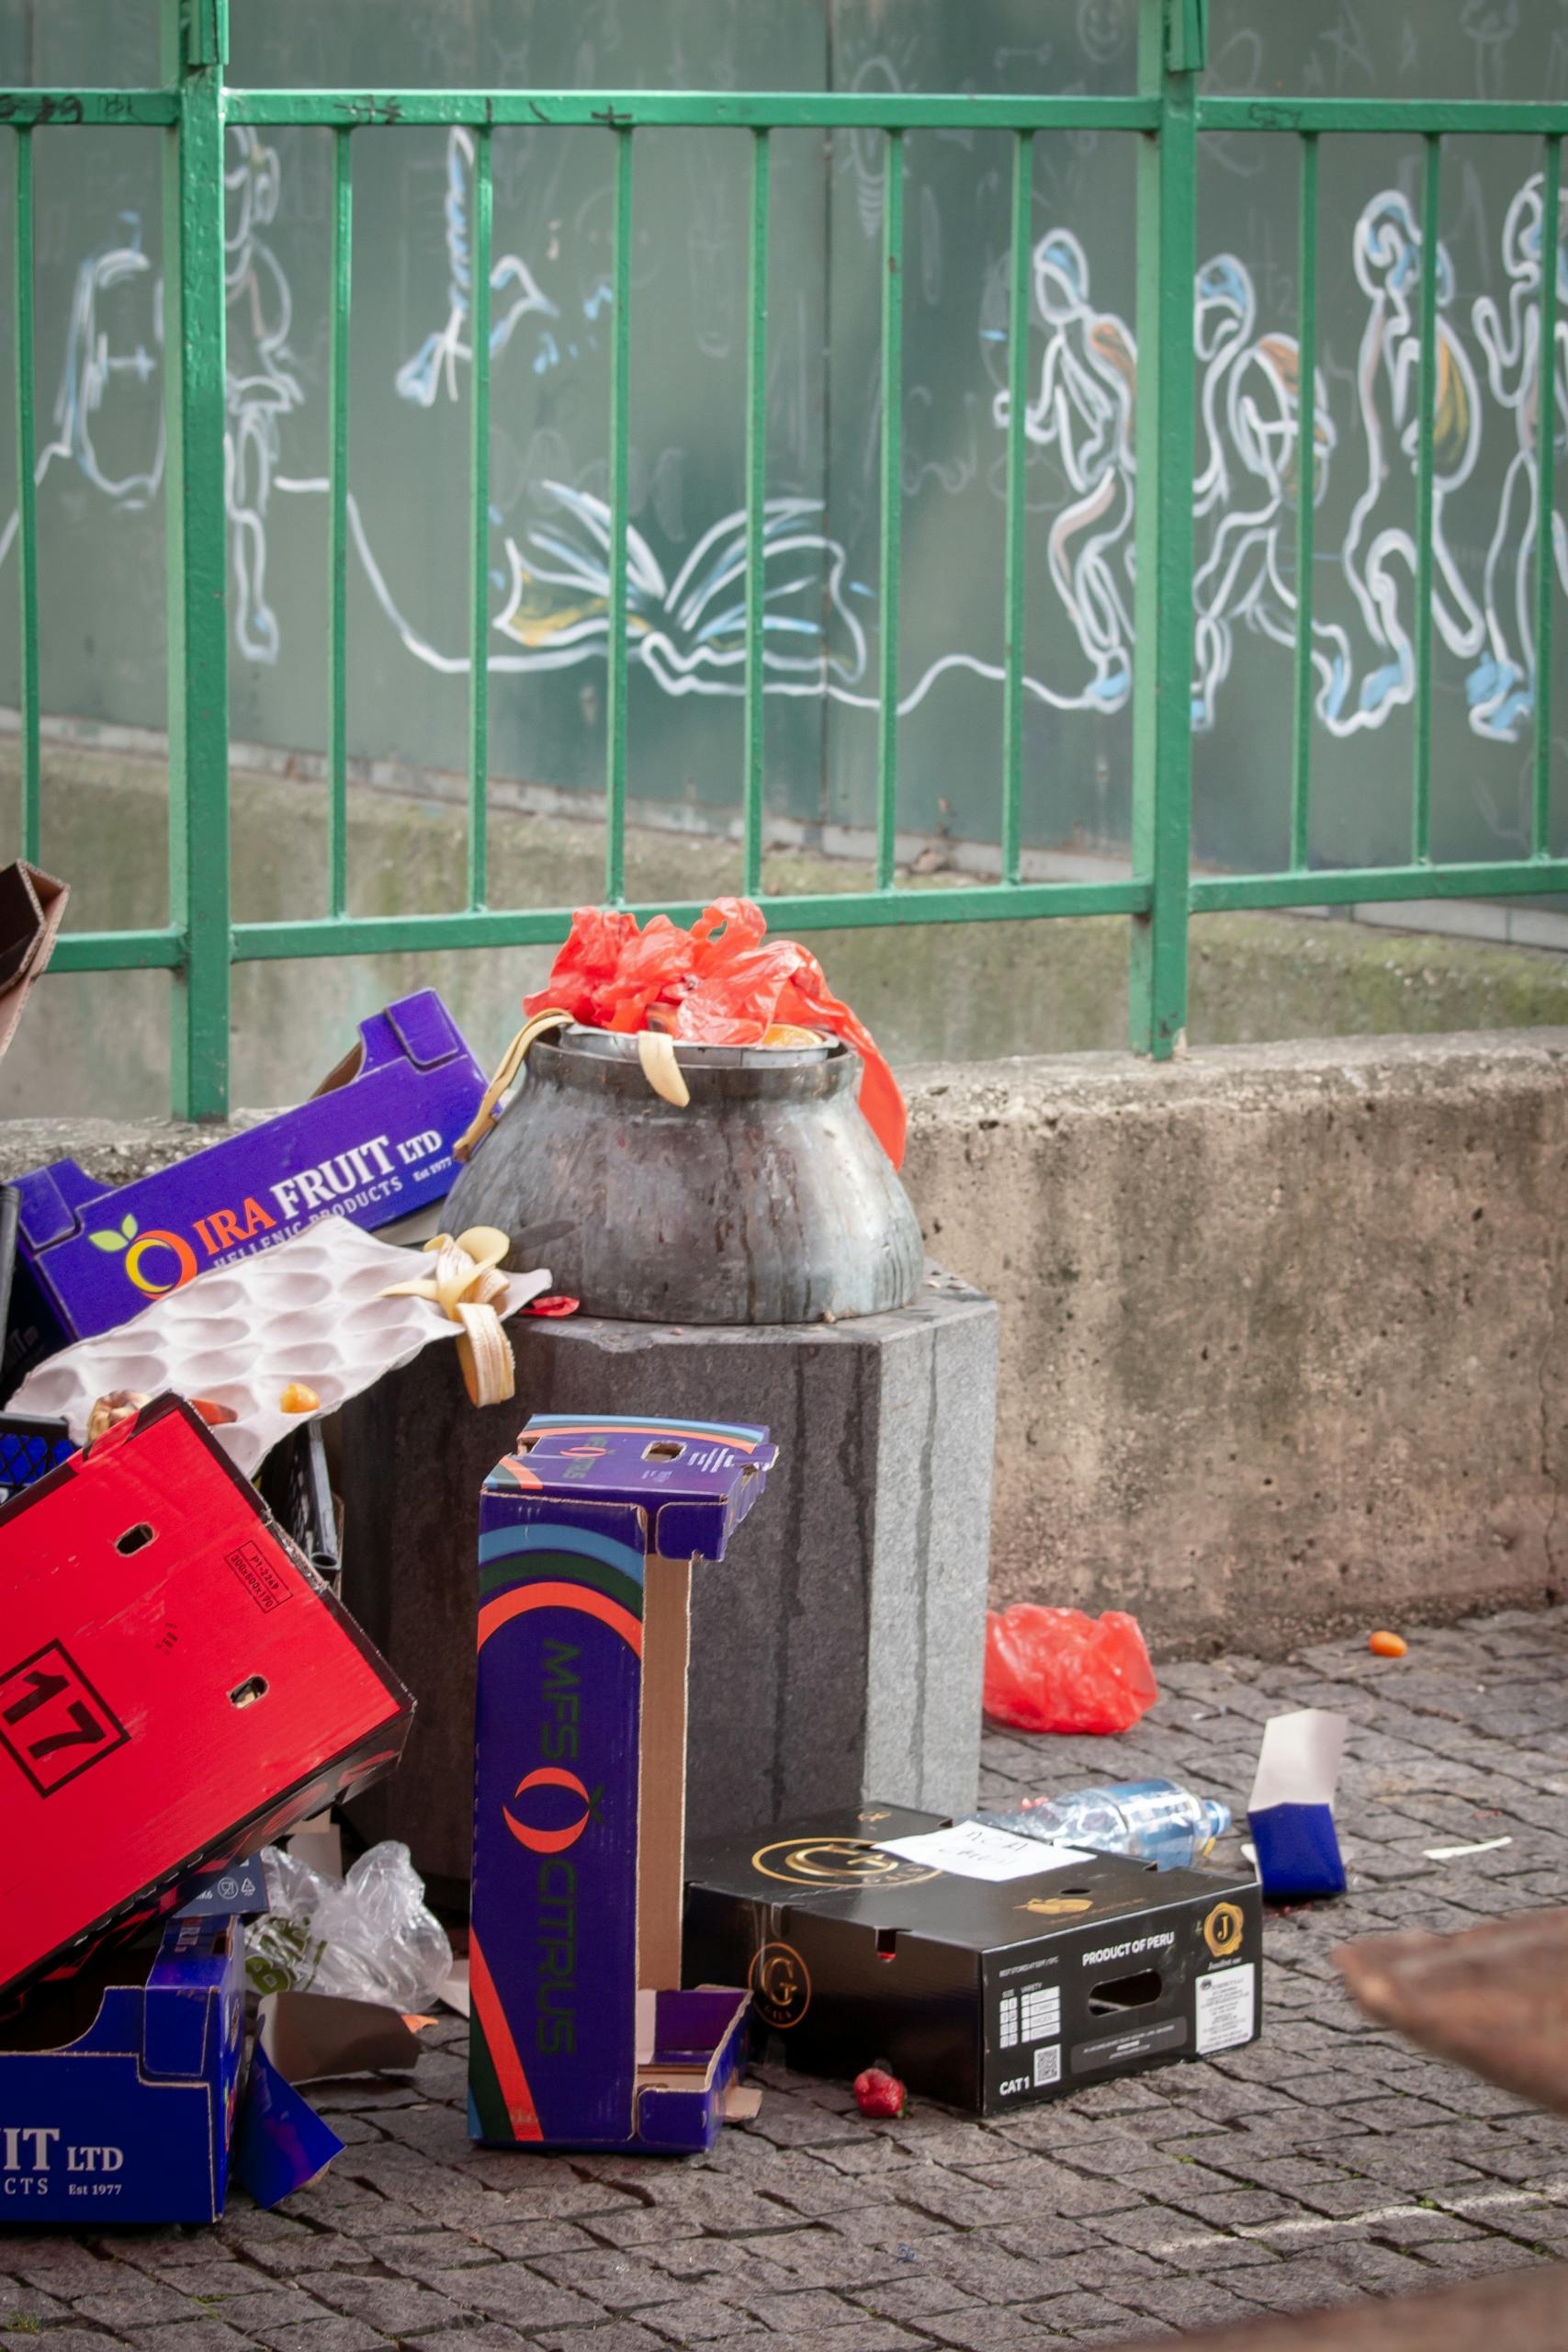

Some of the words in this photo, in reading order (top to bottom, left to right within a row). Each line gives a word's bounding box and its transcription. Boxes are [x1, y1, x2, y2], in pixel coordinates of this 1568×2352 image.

[413, 1168, 430, 1182] Est
[429, 1157, 452, 1174] 1977
[192, 1197, 276, 1256] IRA
[269, 1135, 395, 1220] FRUIT
[396, 1130, 442, 1165] LTD
[2, 1670, 107, 1761] 17
[540, 1638, 581, 1760] MFS
[1082, 1941, 1132, 1967] PRODUCT
[1131, 1938, 1146, 1953] OF
[1146, 1931, 1175, 1950] PERU
[1216, 1916, 1229, 1940] J
[536, 1858, 577, 2055] CITRUS
[761, 1957, 798, 2006] G
[66, 2146, 124, 2172] LTD
[68, 2183, 88, 2195] Est
[92, 2183, 122, 2196] 1977
